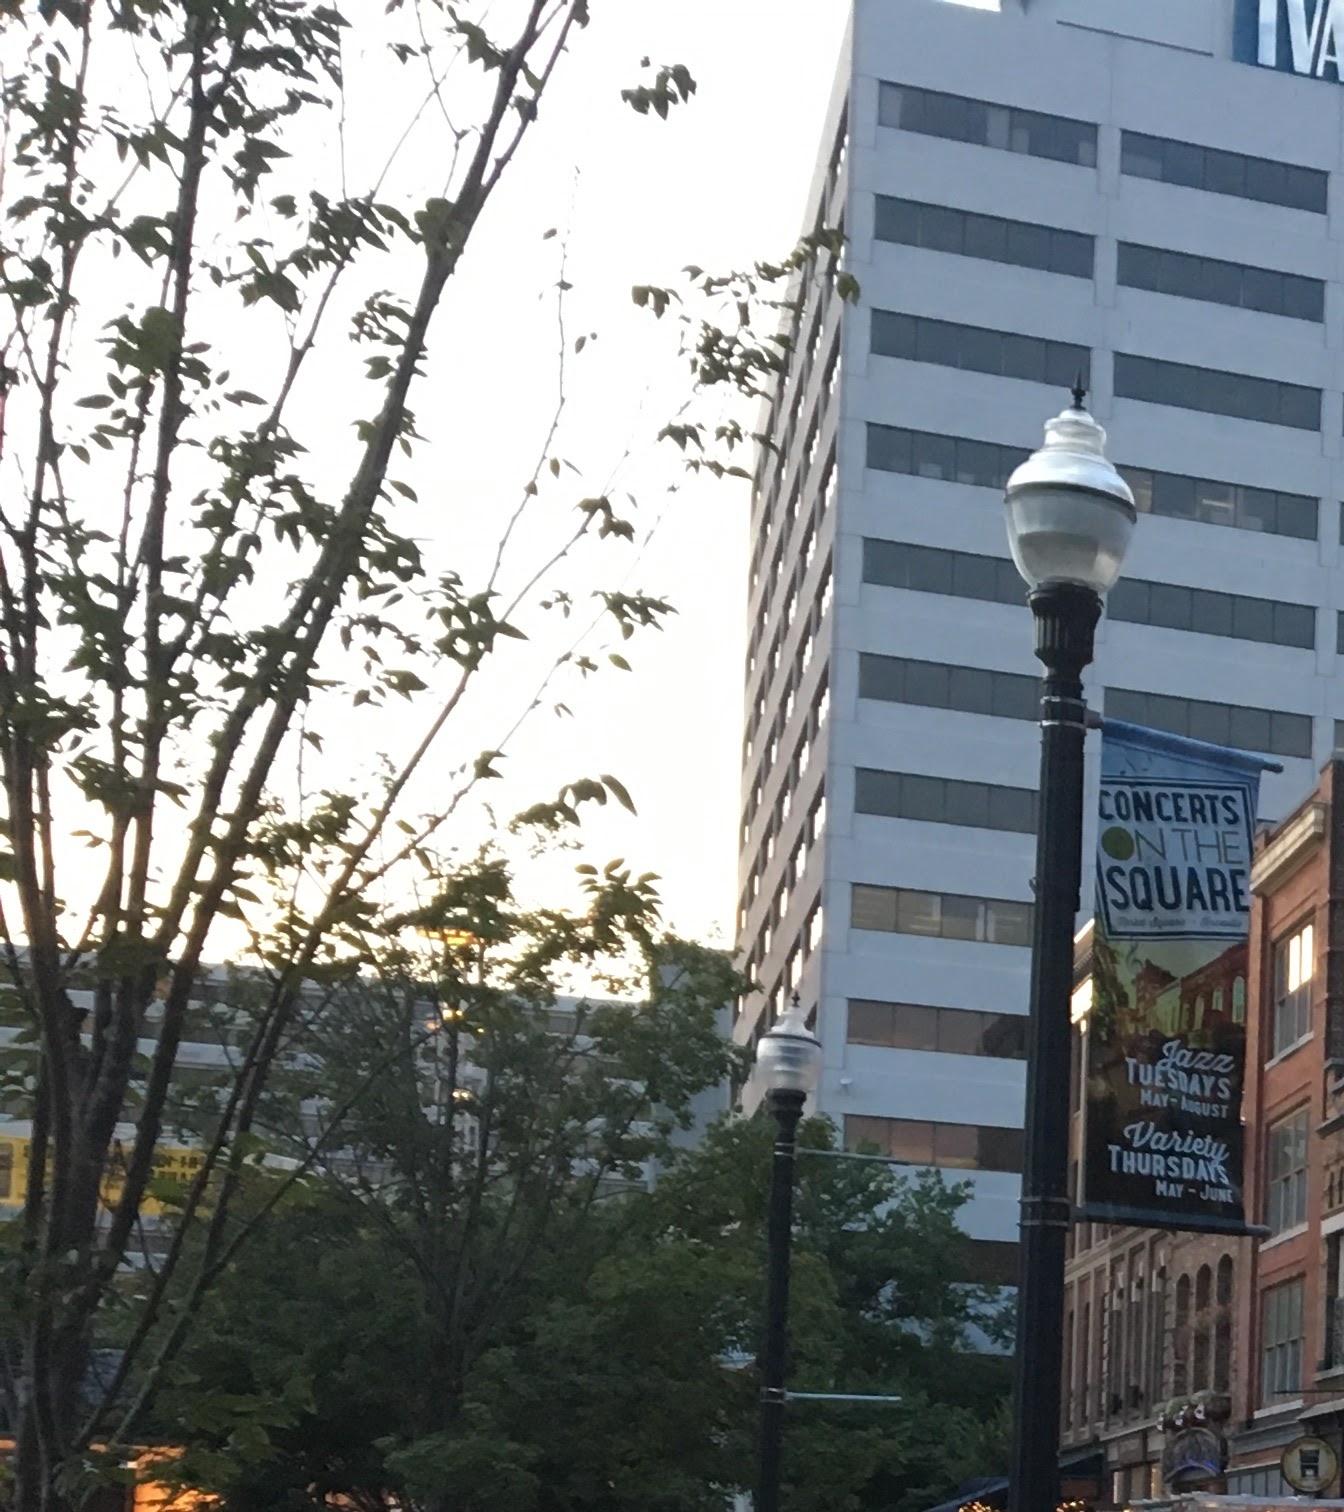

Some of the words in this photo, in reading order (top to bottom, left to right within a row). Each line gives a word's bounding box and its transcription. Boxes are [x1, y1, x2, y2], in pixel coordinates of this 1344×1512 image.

[1099, 789, 1240, 825] CONCERTS
[1101, 826, 1167, 862] ON
[1171, 828, 1243, 865] THE
[1106, 865, 1250, 912] SQUARE
[1157, 1039, 1235, 1073] Jazz
[1125, 1056, 1232, 1100] TUESDAYS
[1123, 1121, 1230, 1166] Variety
[1108, 1144, 1230, 1185] THURSDAYS
